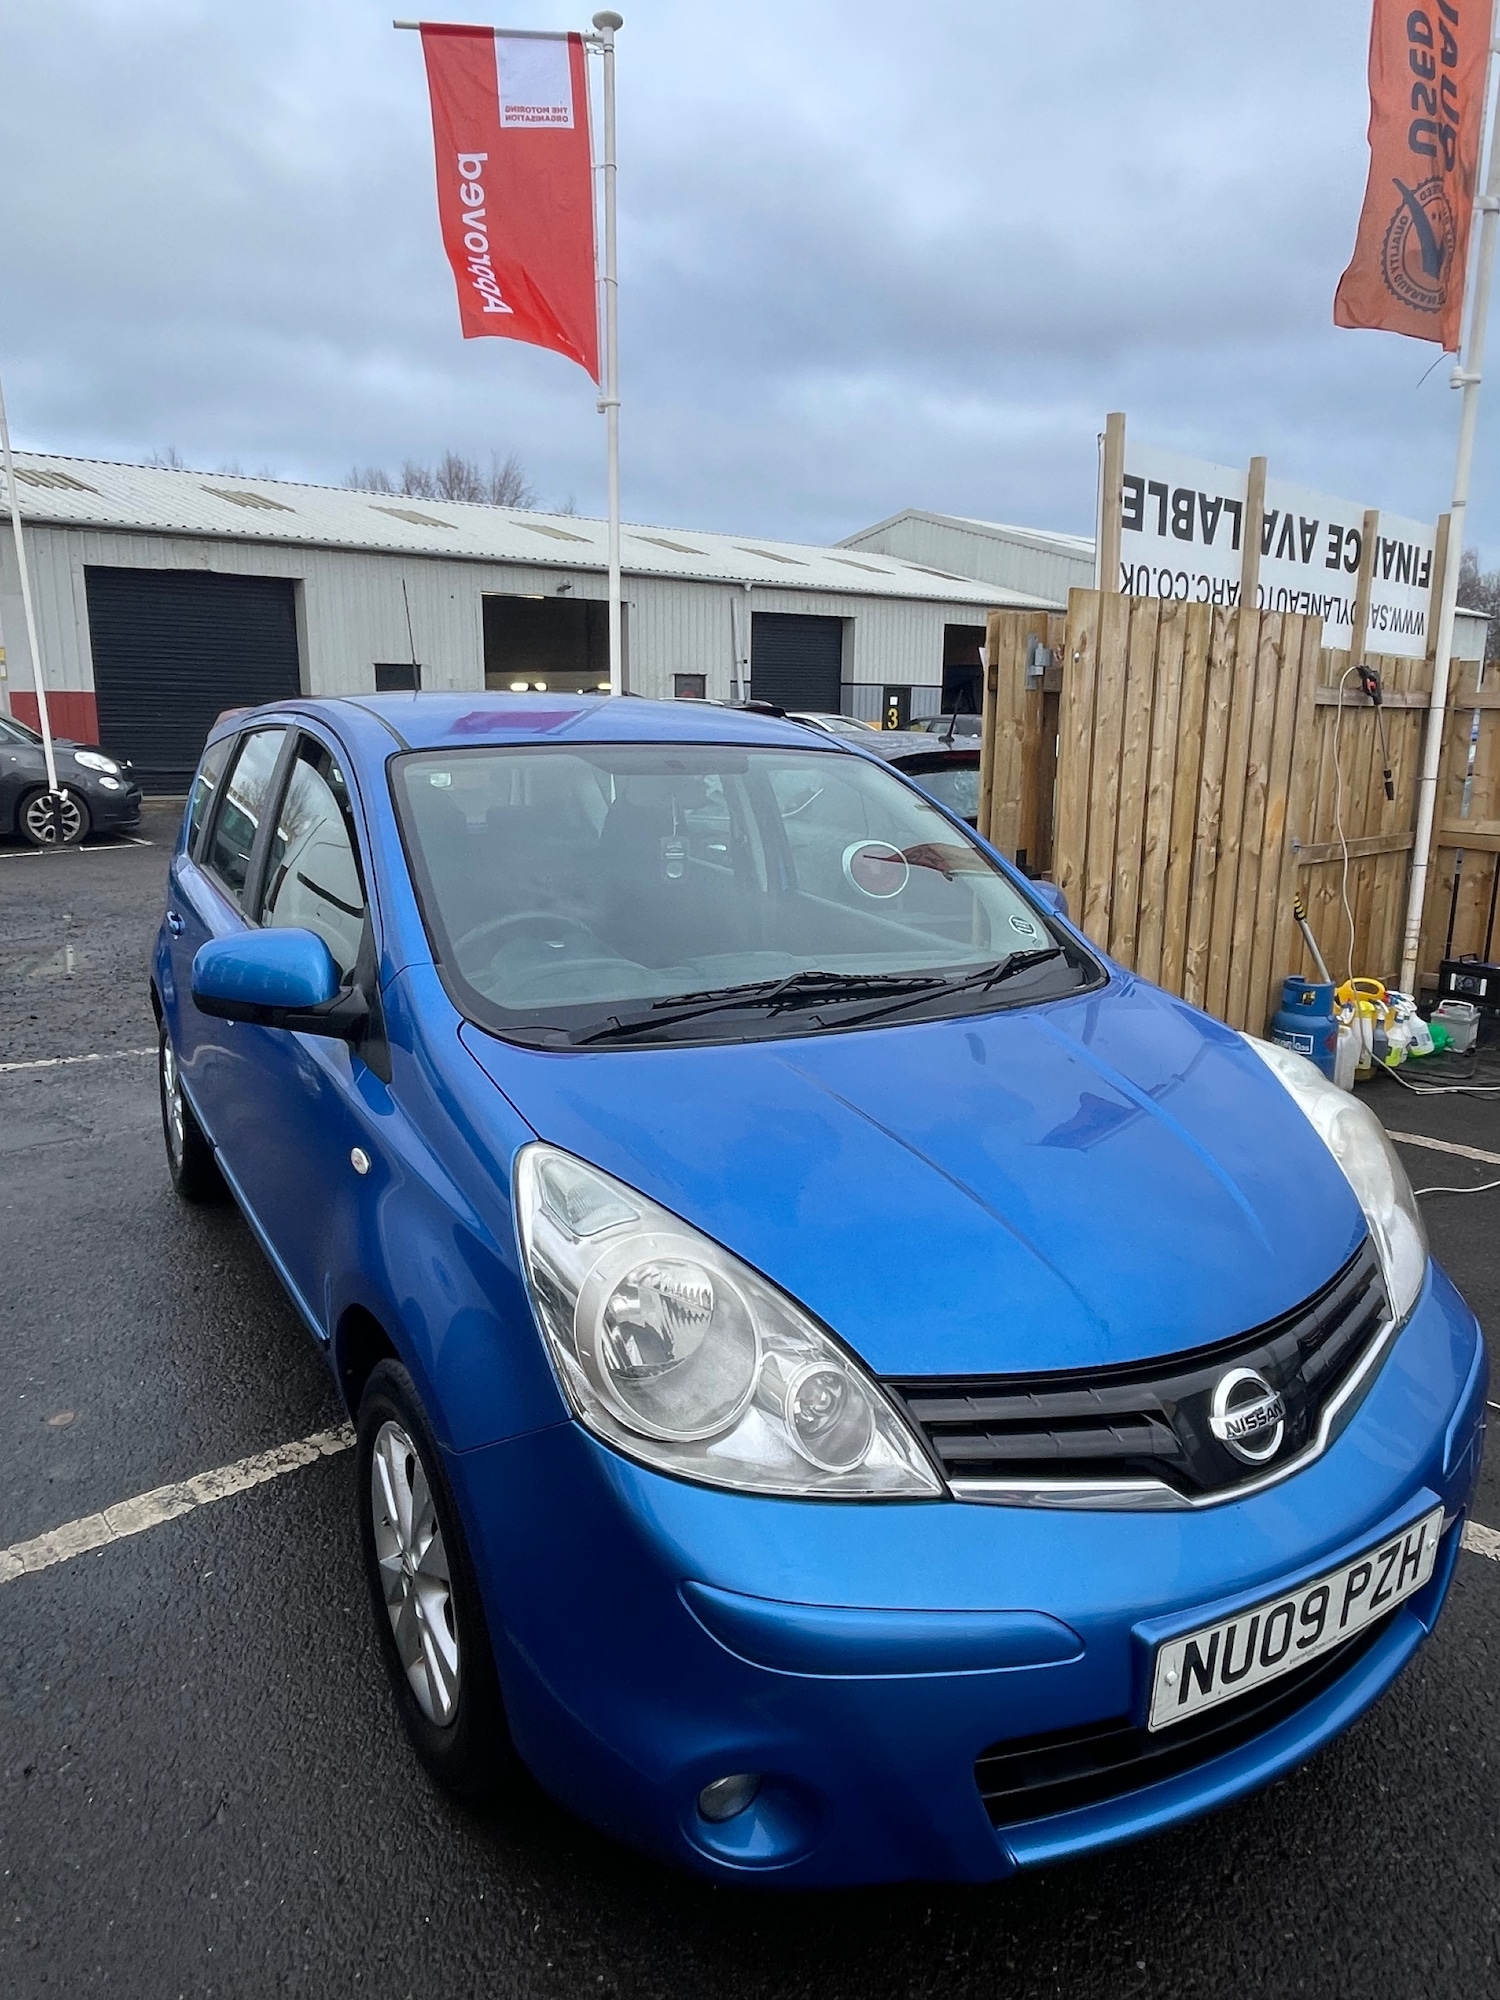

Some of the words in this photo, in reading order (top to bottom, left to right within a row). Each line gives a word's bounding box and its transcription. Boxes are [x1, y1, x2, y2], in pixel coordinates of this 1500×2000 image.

[1122, 473, 1320, 564] AVALABLE
[887, 707, 899, 730] 3
[1225, 1399, 1284, 1439] NISSAN
[1178, 1585, 1330, 1706] NU09
[1338, 1525, 1428, 1629] PZH
